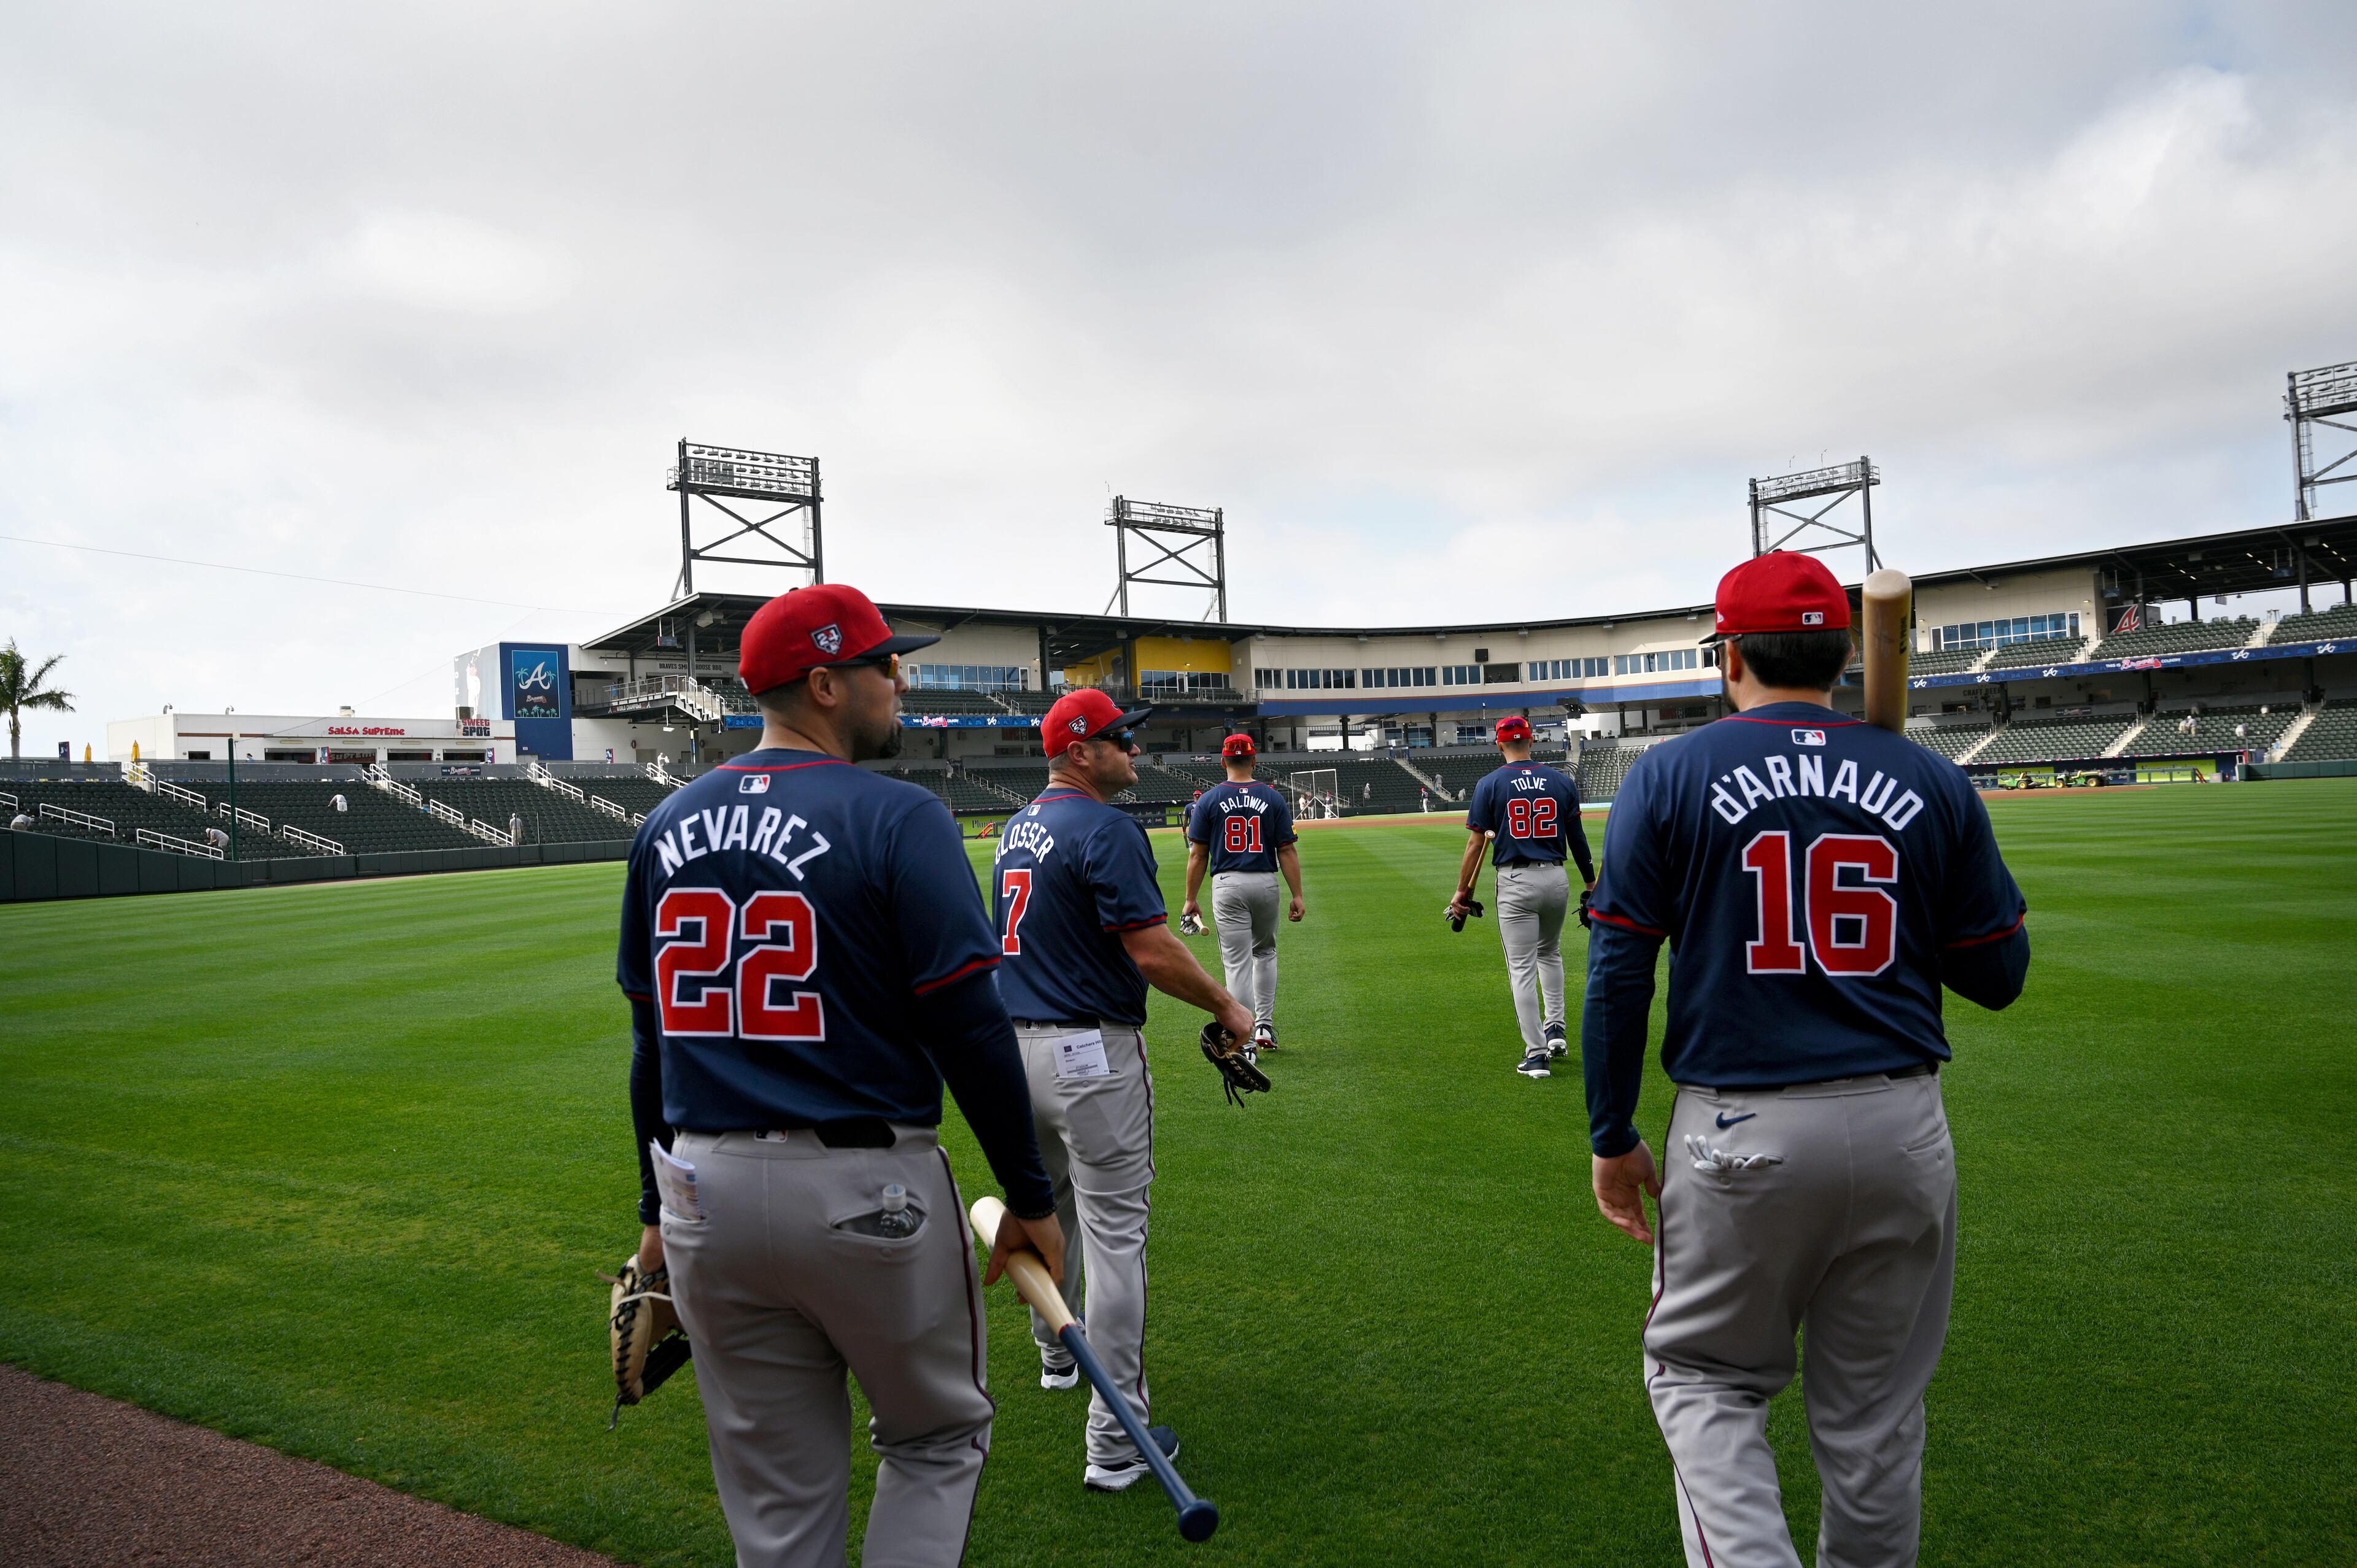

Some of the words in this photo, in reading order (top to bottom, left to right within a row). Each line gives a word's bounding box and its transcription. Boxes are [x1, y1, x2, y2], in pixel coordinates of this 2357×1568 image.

[1219, 795, 1269, 814] BALDWIN
[1510, 776, 1547, 792] TOLVE
[1710, 754, 1924, 831] d'ARNAUD
[653, 805, 831, 881] NEVAREZ
[995, 821, 1055, 865] CLOSSER
[1225, 816, 1263, 852] 81
[1507, 797, 1557, 839] 82
[1002, 868, 1032, 955] 7
[1741, 830, 1899, 976] 16
[654, 887, 826, 1041] 22
